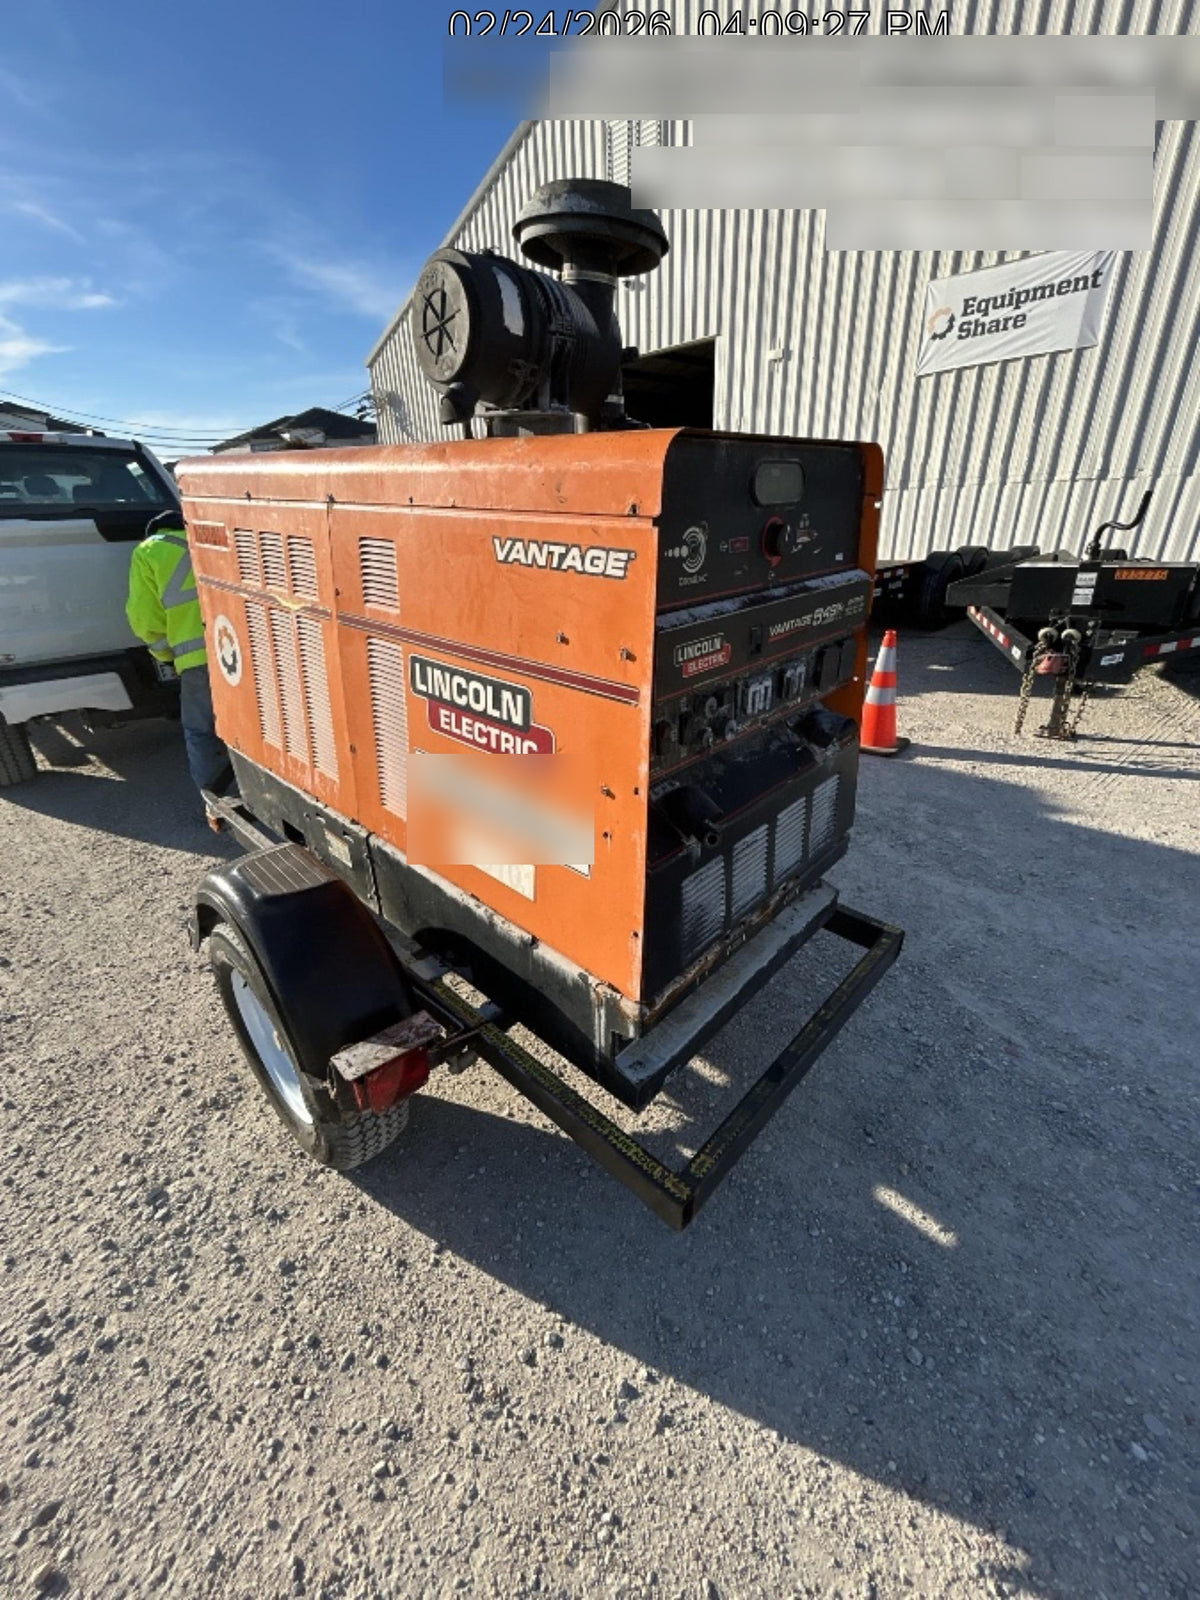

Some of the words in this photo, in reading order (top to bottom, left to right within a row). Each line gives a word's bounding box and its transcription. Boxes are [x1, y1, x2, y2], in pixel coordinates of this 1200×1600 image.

[961, 269, 1103, 317] Equipment
[957, 312, 1027, 340] Share
[493, 536, 629, 579] VANTAGE
[769, 614, 812, 636] VANTAGE
[678, 637, 721, 662] LINCOLN
[688, 651, 726, 672] ELECTRIC
[415, 663, 524, 726] LINCOLN
[439, 709, 538, 754] ELECTRIC
